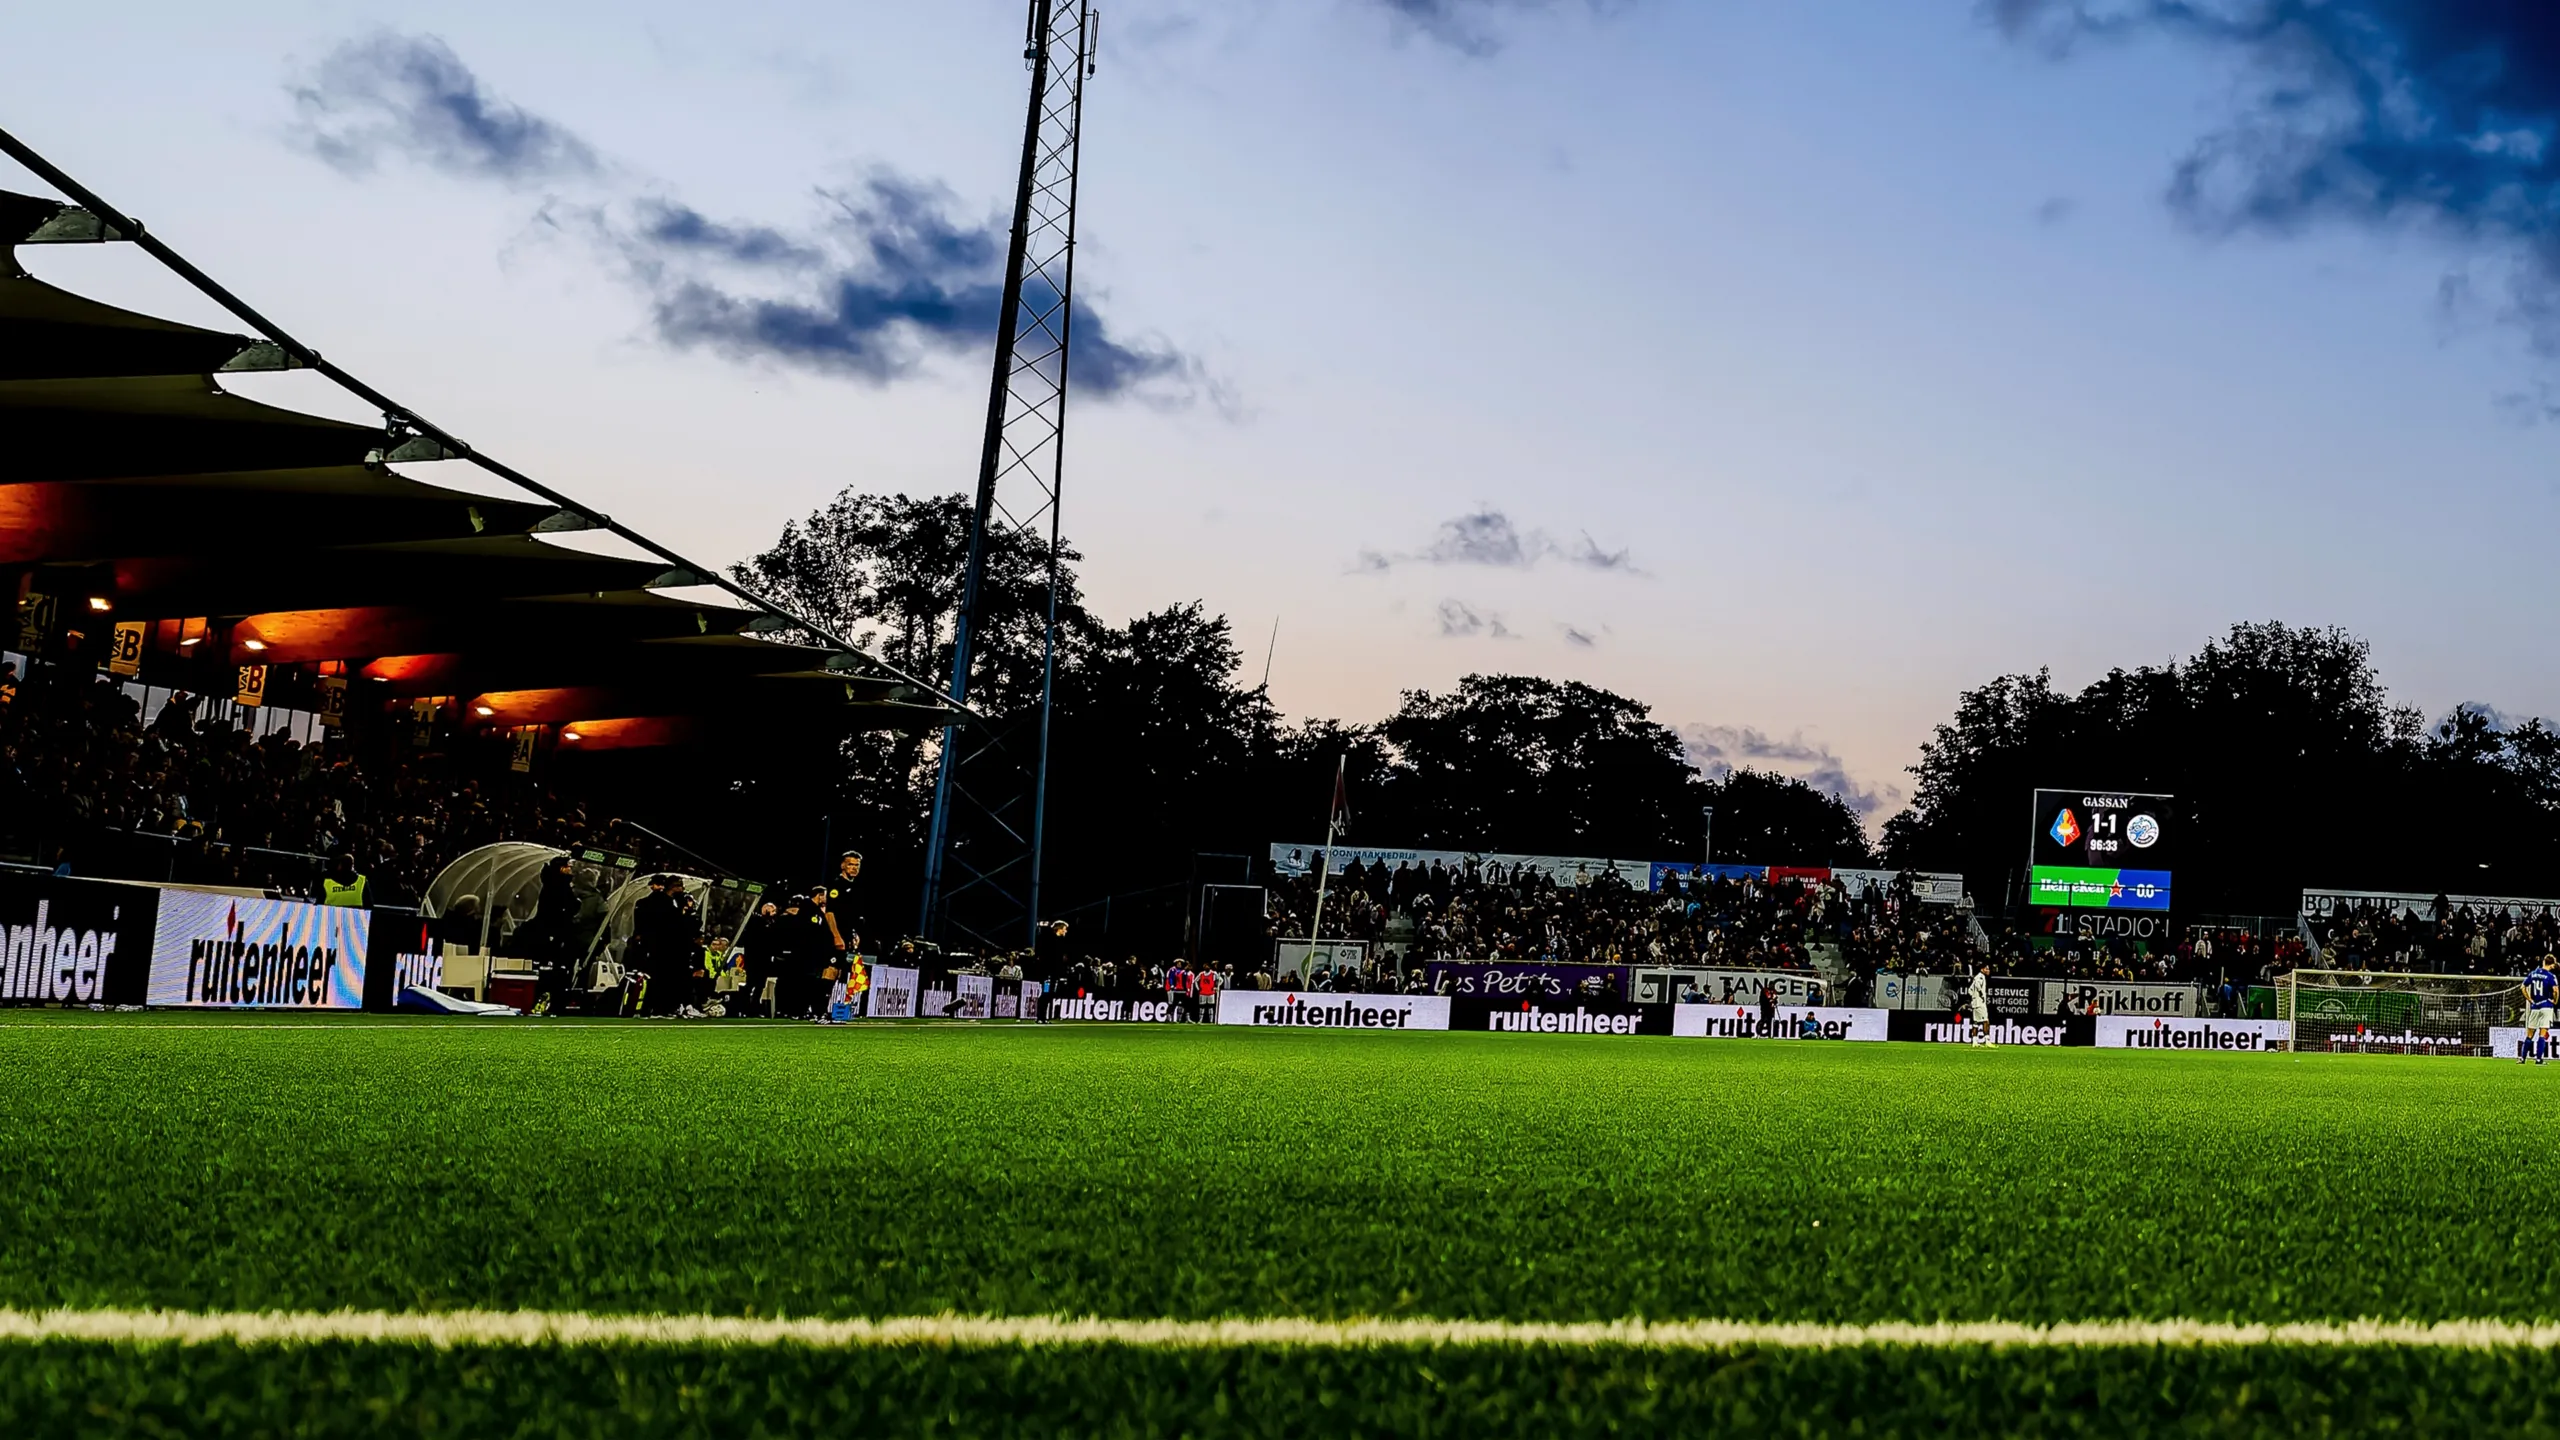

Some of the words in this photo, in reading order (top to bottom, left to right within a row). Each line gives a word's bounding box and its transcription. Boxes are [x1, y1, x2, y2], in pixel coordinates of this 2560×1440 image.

[110, 628, 125, 659] VAK
[120, 628, 141, 661] B
[247, 665, 264, 693] B
[2083, 797, 2128, 809] GASSAN
[2092, 813, 2116, 834] 1-1
[2090, 839, 2118, 851] 96:33
[2040, 878, 2105, 893] Heineken
[186, 901, 338, 1004] ruitenheer
[1994, 988, 2029, 997] SERVICE
[2080, 986, 2184, 1014] Rijkhoff
[2532, 980, 2544, 996] 14
[1253, 994, 1412, 1028] ruitenheer
[1489, 1002, 1642, 1034] ruitenheer
[2126, 1019, 2262, 1049] ruitenheer
